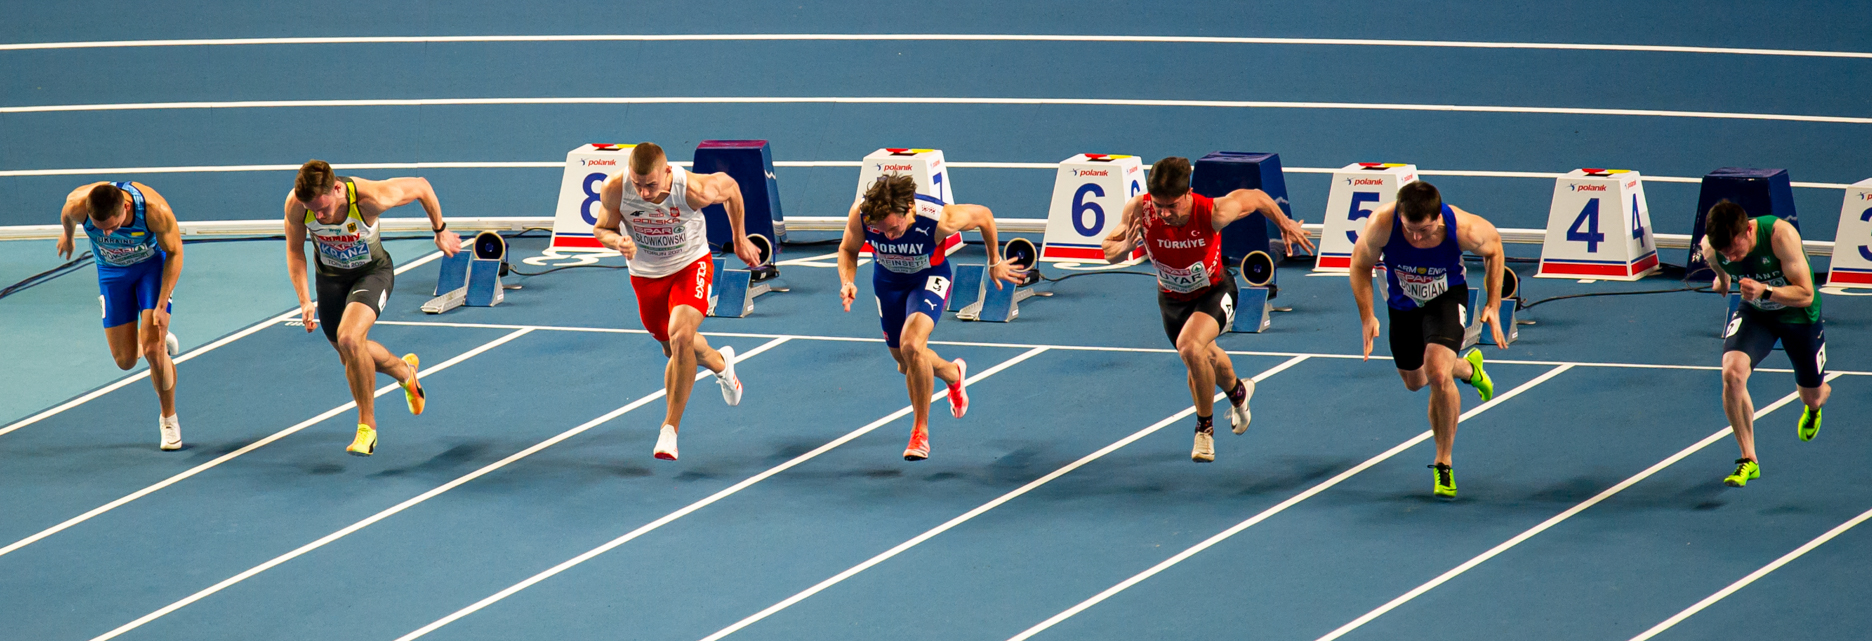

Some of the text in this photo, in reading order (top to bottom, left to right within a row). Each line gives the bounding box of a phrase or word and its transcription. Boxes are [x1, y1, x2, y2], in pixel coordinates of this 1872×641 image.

[1080, 169, 1108, 177] polanik
[1354, 178, 1383, 186] polanik
[1577, 184, 1607, 192] polanik
[1071, 183, 1105, 237] 6
[1346, 191, 1380, 245] 5
[1632, 193, 1645, 248] 4
[635, 227, 671, 235] SPAR
[1566, 198, 1604, 253] 4
[871, 240, 923, 254] NORWAY
[1157, 239, 1206, 249] TÜRKİYE
[321, 244, 368, 259] KRANZ
[694, 261, 707, 299] POLSKA
[1159, 271, 1203, 284] UYAR
[933, 278, 942, 291] 5
